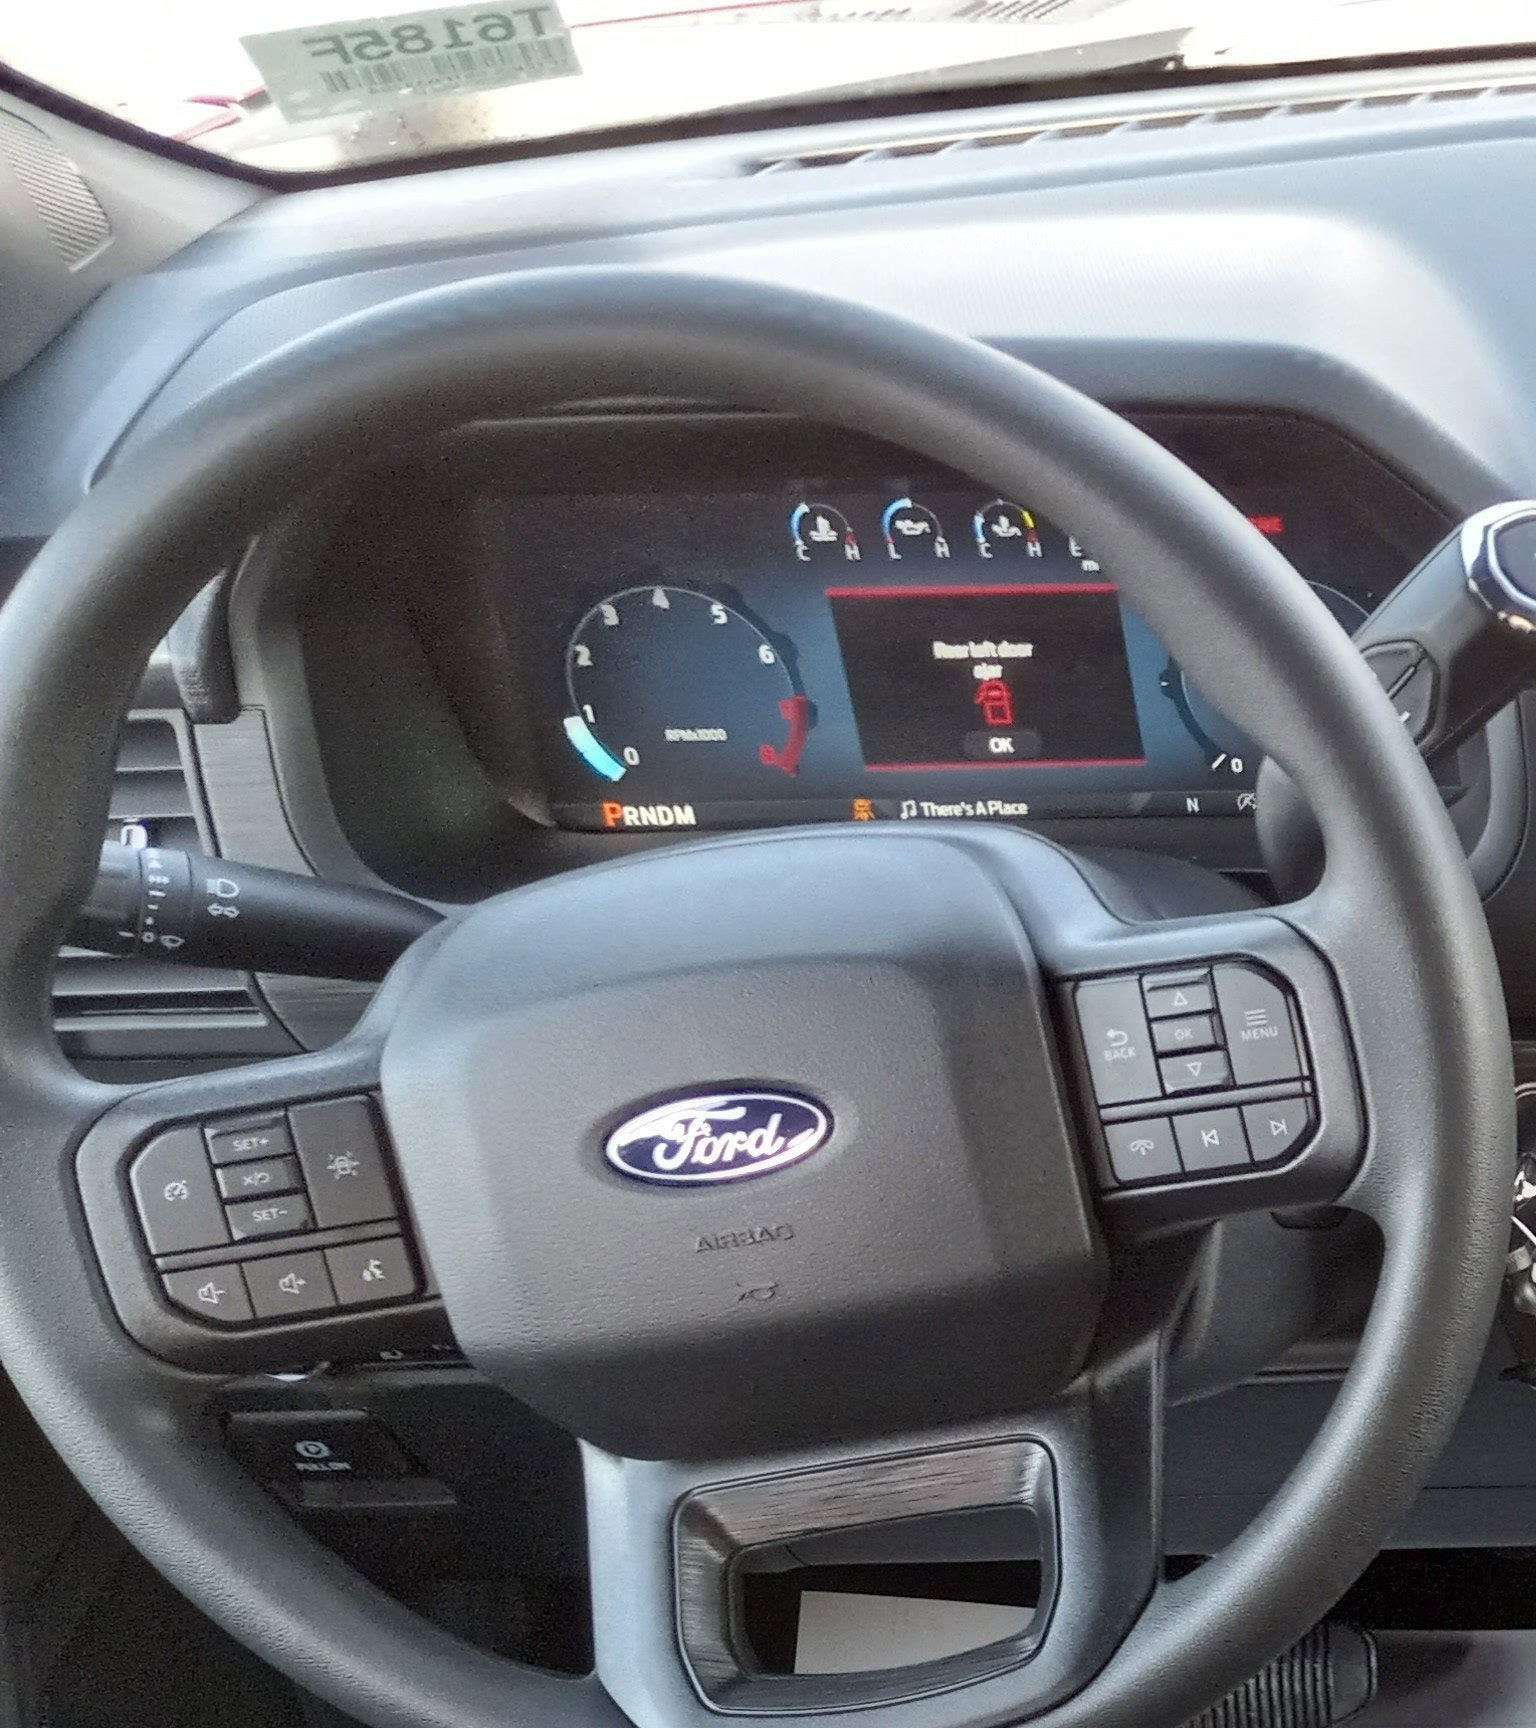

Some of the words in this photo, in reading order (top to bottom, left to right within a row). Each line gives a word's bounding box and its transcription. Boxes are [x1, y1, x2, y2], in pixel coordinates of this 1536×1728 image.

[711, 603, 727, 625] 5
[758, 644, 775, 664] 6
[989, 737, 1014, 753] OK
[921, 802, 974, 816] There's
[976, 801, 988, 815] A
[989, 801, 1028, 815] Place
[1174, 1028, 1192, 1041] OK
[1241, 1027, 1279, 1041] MENU
[1104, 1047, 1135, 1062] BACK
[652, 1104, 785, 1171] Ford
